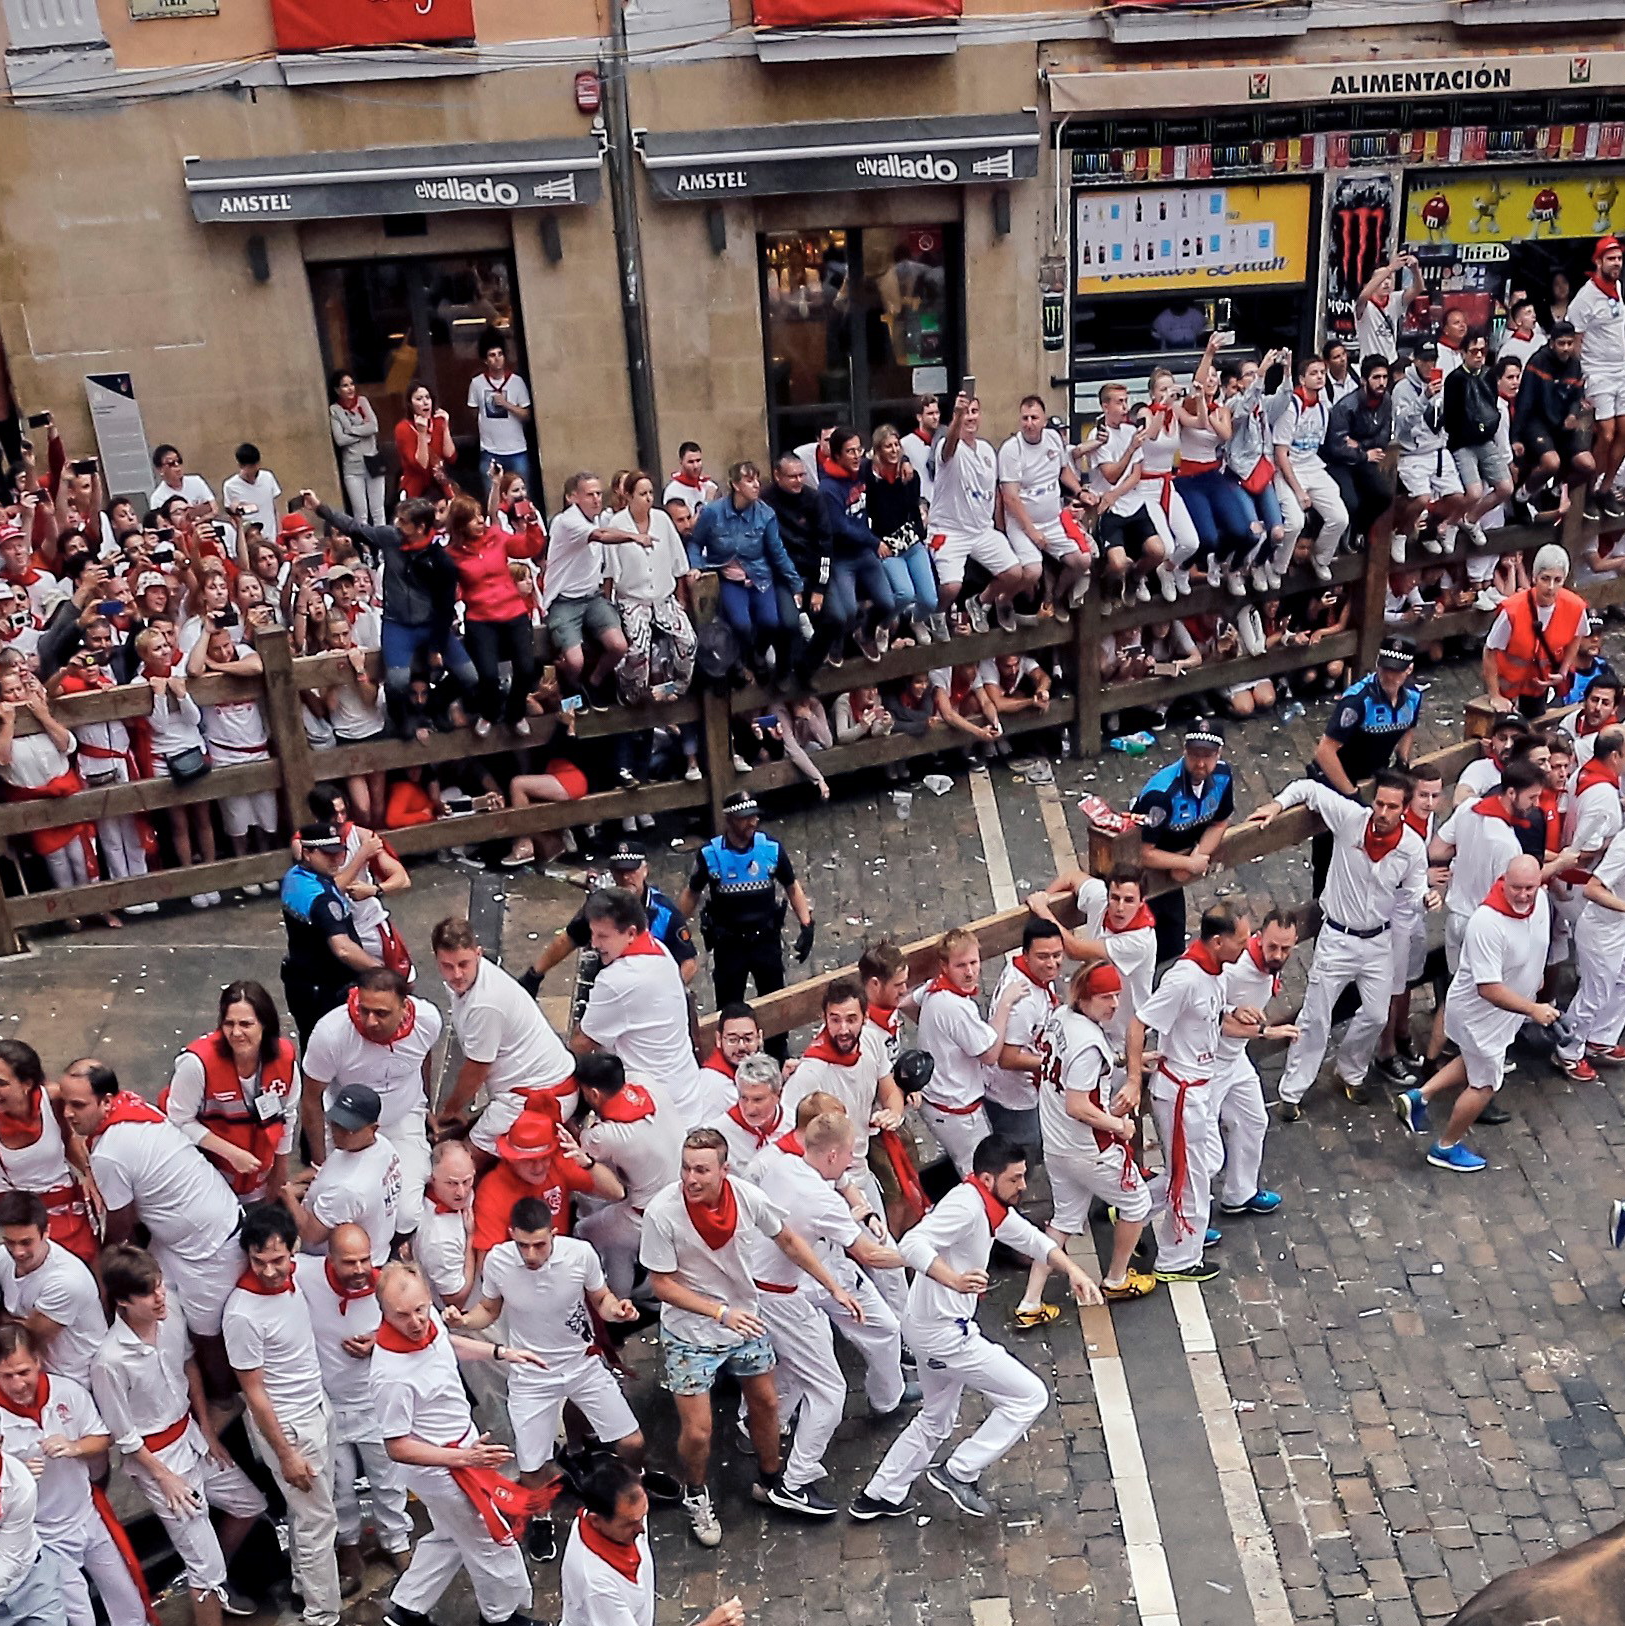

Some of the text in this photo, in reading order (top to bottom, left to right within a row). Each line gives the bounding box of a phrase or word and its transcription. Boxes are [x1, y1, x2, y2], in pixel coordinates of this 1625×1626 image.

[1331, 63, 1511, 94] ALIMENTACIÓN
[677, 172, 746, 191] AMSTEL
[220, 195, 291, 213] AMSTEL
